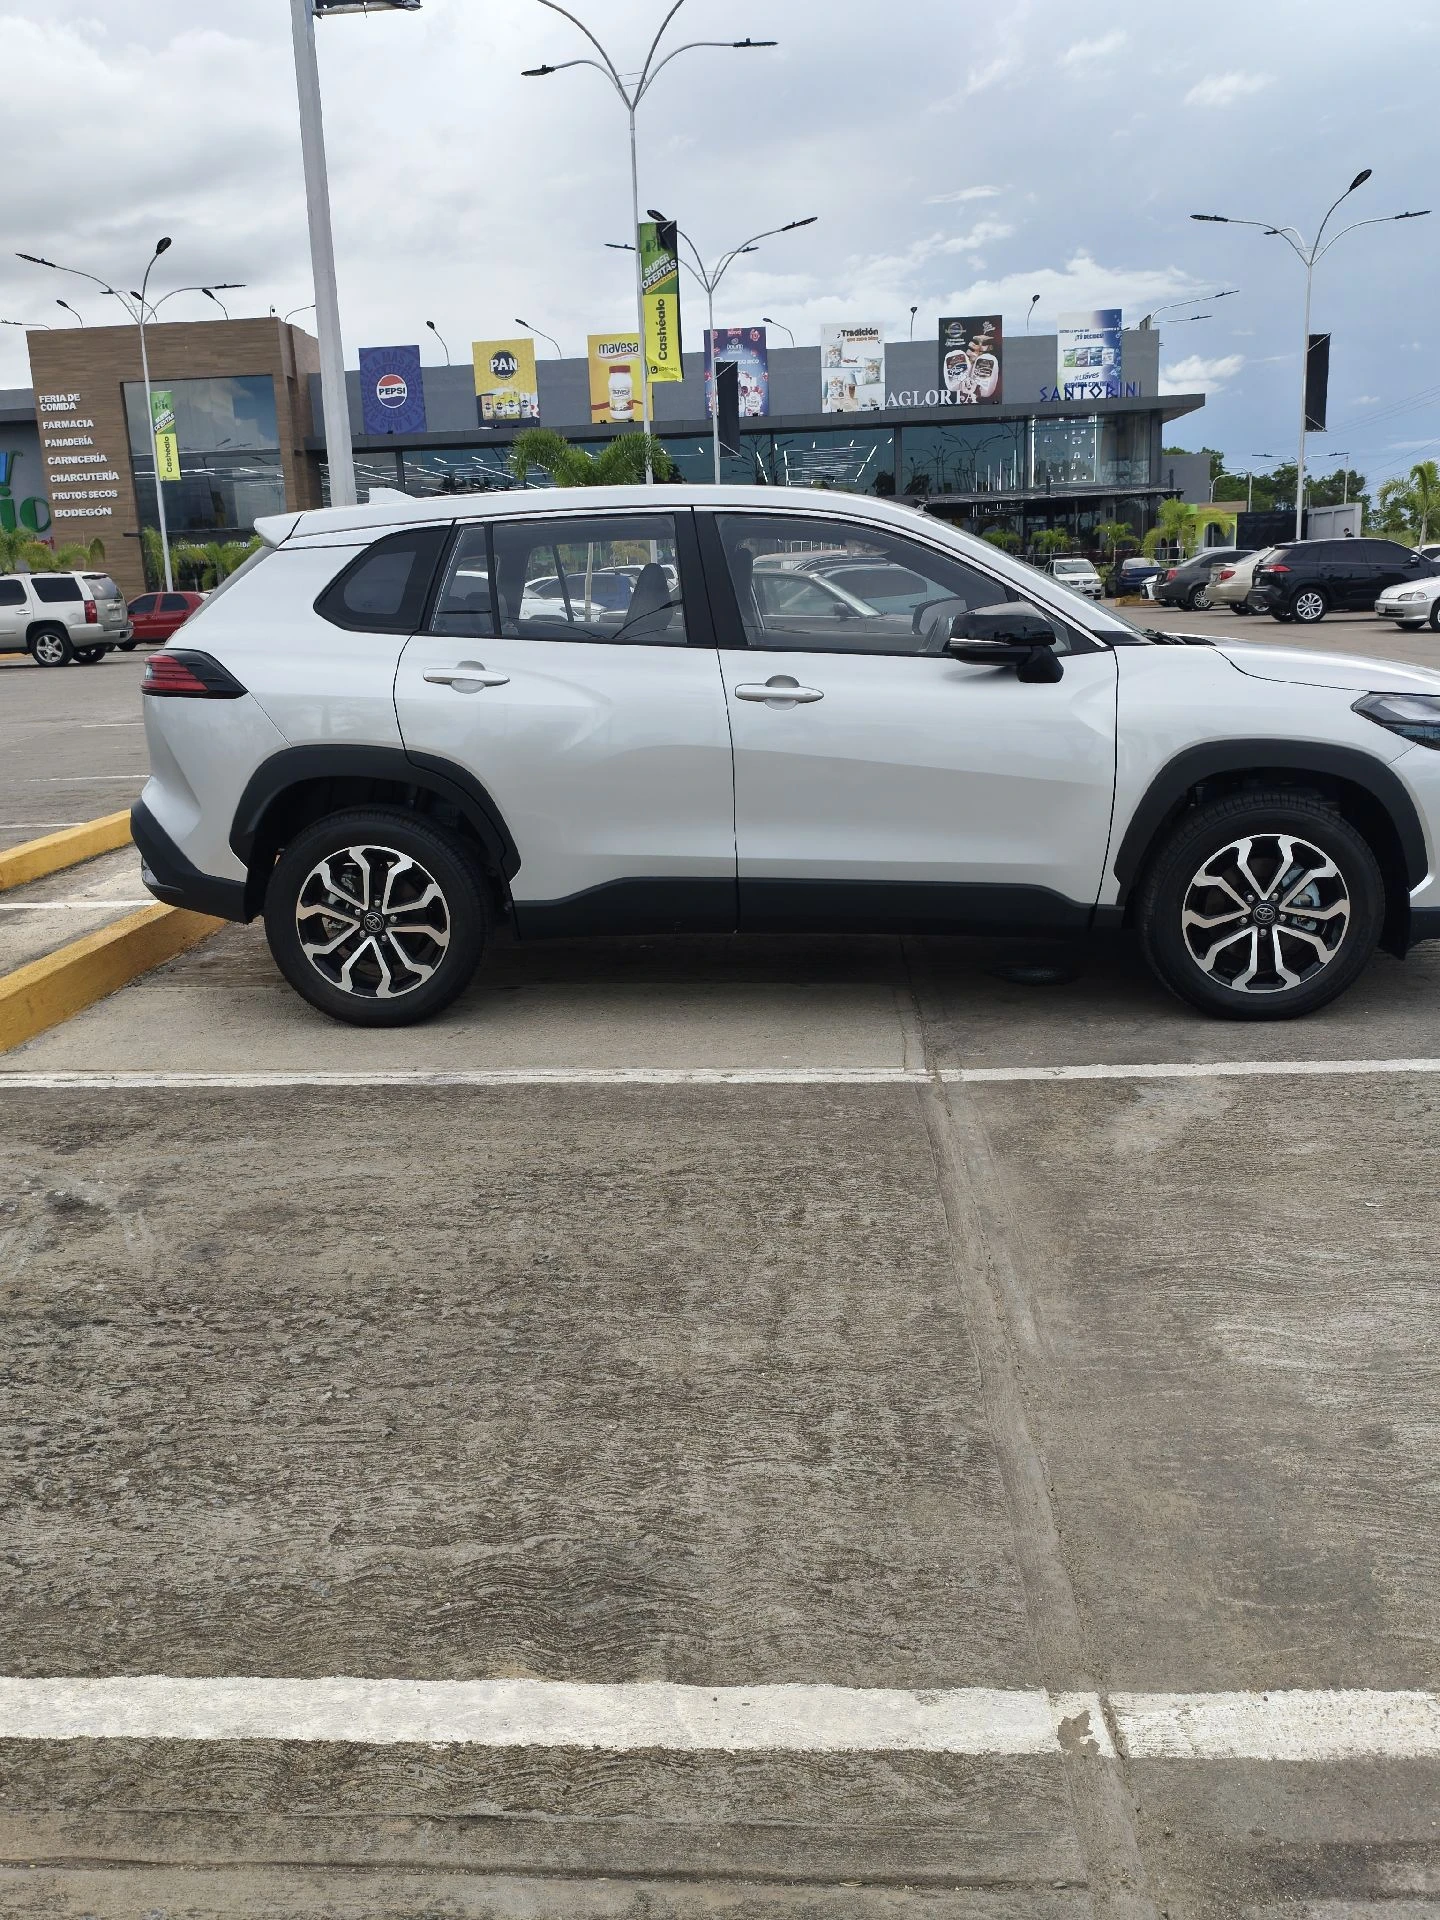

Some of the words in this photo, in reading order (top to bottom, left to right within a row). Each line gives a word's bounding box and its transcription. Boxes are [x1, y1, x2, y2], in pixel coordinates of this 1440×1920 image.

[644, 253, 670, 276] SUPER
[642, 259, 677, 289] OFERTAS
[656, 299, 668, 360] Cashéalo
[841, 328, 879, 337] Tradición
[598, 342, 639, 354] mavesa
[379, 387, 406, 396] PEPSI
[39, 394, 67, 404] FERIA
[67, 393, 80, 402] DE
[40, 402, 77, 412] COMIDA
[42, 419, 94, 430] FARMACIA
[44, 435, 93, 448] PANADERÍA
[47, 452, 107, 465] CARNICERÍA
[50, 470, 120, 483] CHARCUTERÍA
[52, 491, 87, 500] FRUTOS
[88, 489, 118, 499] SECOS
[54, 505, 112, 518] BODEGÓN
